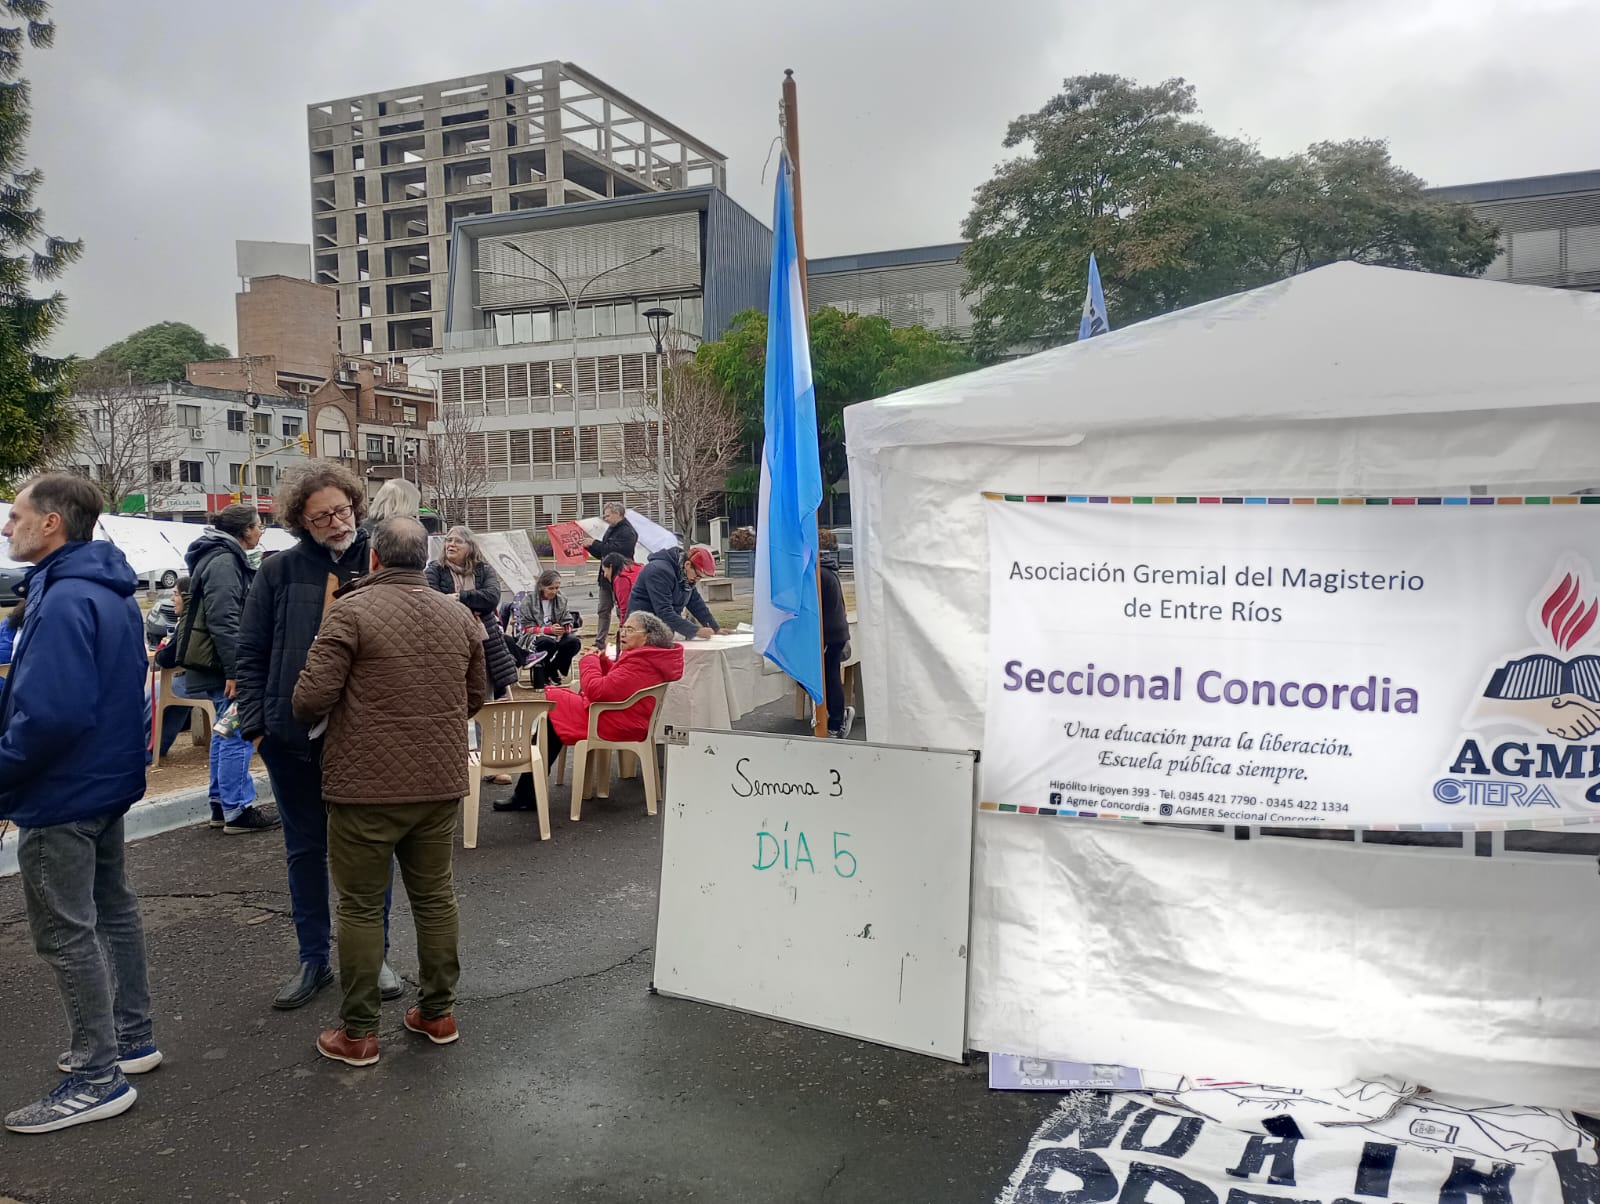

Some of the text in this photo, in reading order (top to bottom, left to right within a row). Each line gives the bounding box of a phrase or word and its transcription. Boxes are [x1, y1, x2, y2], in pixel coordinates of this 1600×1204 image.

[1009, 560, 1424, 593] Asociación Gremial del Magisterio
[1124, 597, 1282, 622] de Entre Ríos
[1003, 660, 1419, 714] Seccional Concordia
[1064, 720, 1353, 757] Una educación para la liberación.
[731, 757, 843, 798] Semana 3
[1098, 750, 1308, 784] Escuela pública siempre.
[1049, 779, 1087, 792] Hipólito
[1089, 783, 1129, 796] Irigoyen
[1132, 787, 1150, 798] 393
[1160, 789, 1176, 800] Tel.
[1178, 791, 1205, 802] 0345
[1207, 793, 1226, 804] 421
[1230, 795, 1257, 806] 7790
[1266, 797, 1294, 809] 0345
[1296, 800, 1318, 811] 422
[1322, 802, 1349, 812] 1334
[1066, 796, 1098, 808] Agmer
[1100, 799, 1150, 812] Concordia
[1175, 806, 1215, 817] AGMER
[1217, 808, 1267, 821] Seccional
[1433, 778, 1561, 809] CTERA
[752, 821, 857, 878] DÍA 5
